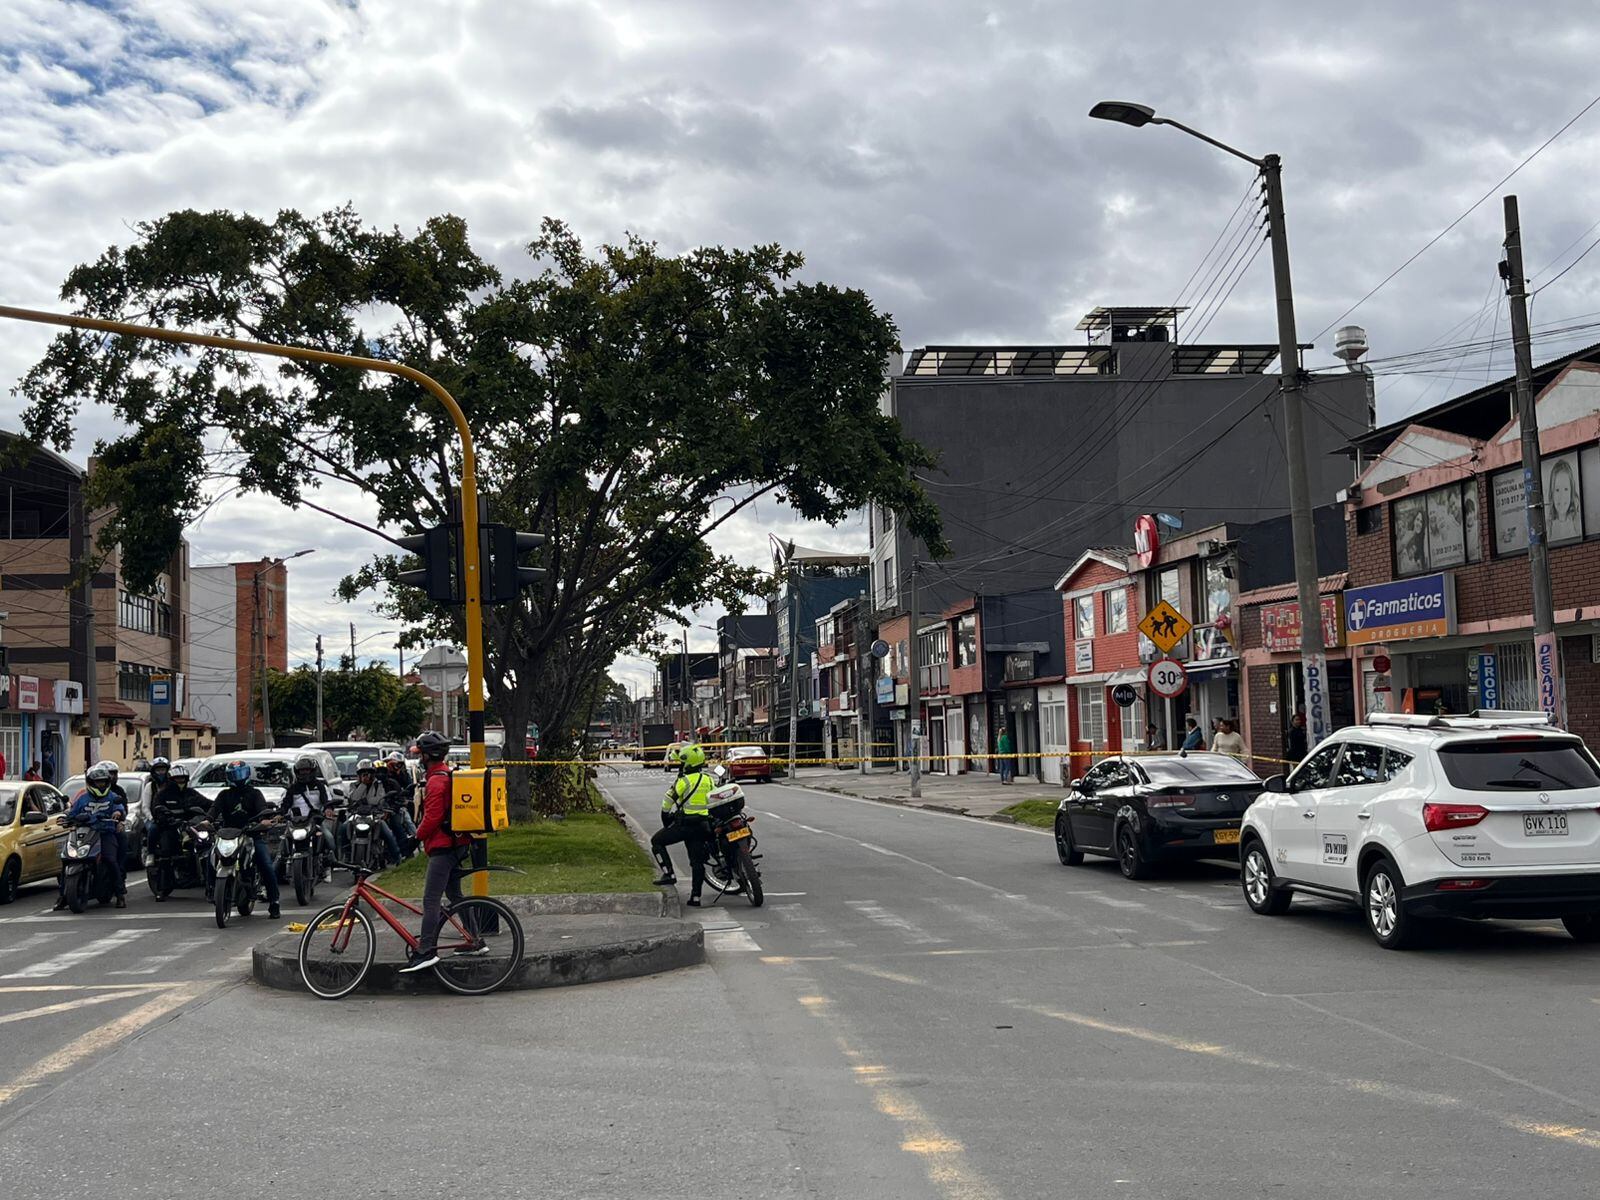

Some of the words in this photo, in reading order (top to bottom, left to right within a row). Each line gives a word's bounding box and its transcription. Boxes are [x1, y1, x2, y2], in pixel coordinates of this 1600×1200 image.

[1366, 592, 1442, 618] Farmaticos
[1371, 624, 1437, 640] DROGUERIA
[1158, 670, 1176, 686] 30
[1525, 817, 1545, 830] GVK
[1548, 816, 1567, 829] 110
